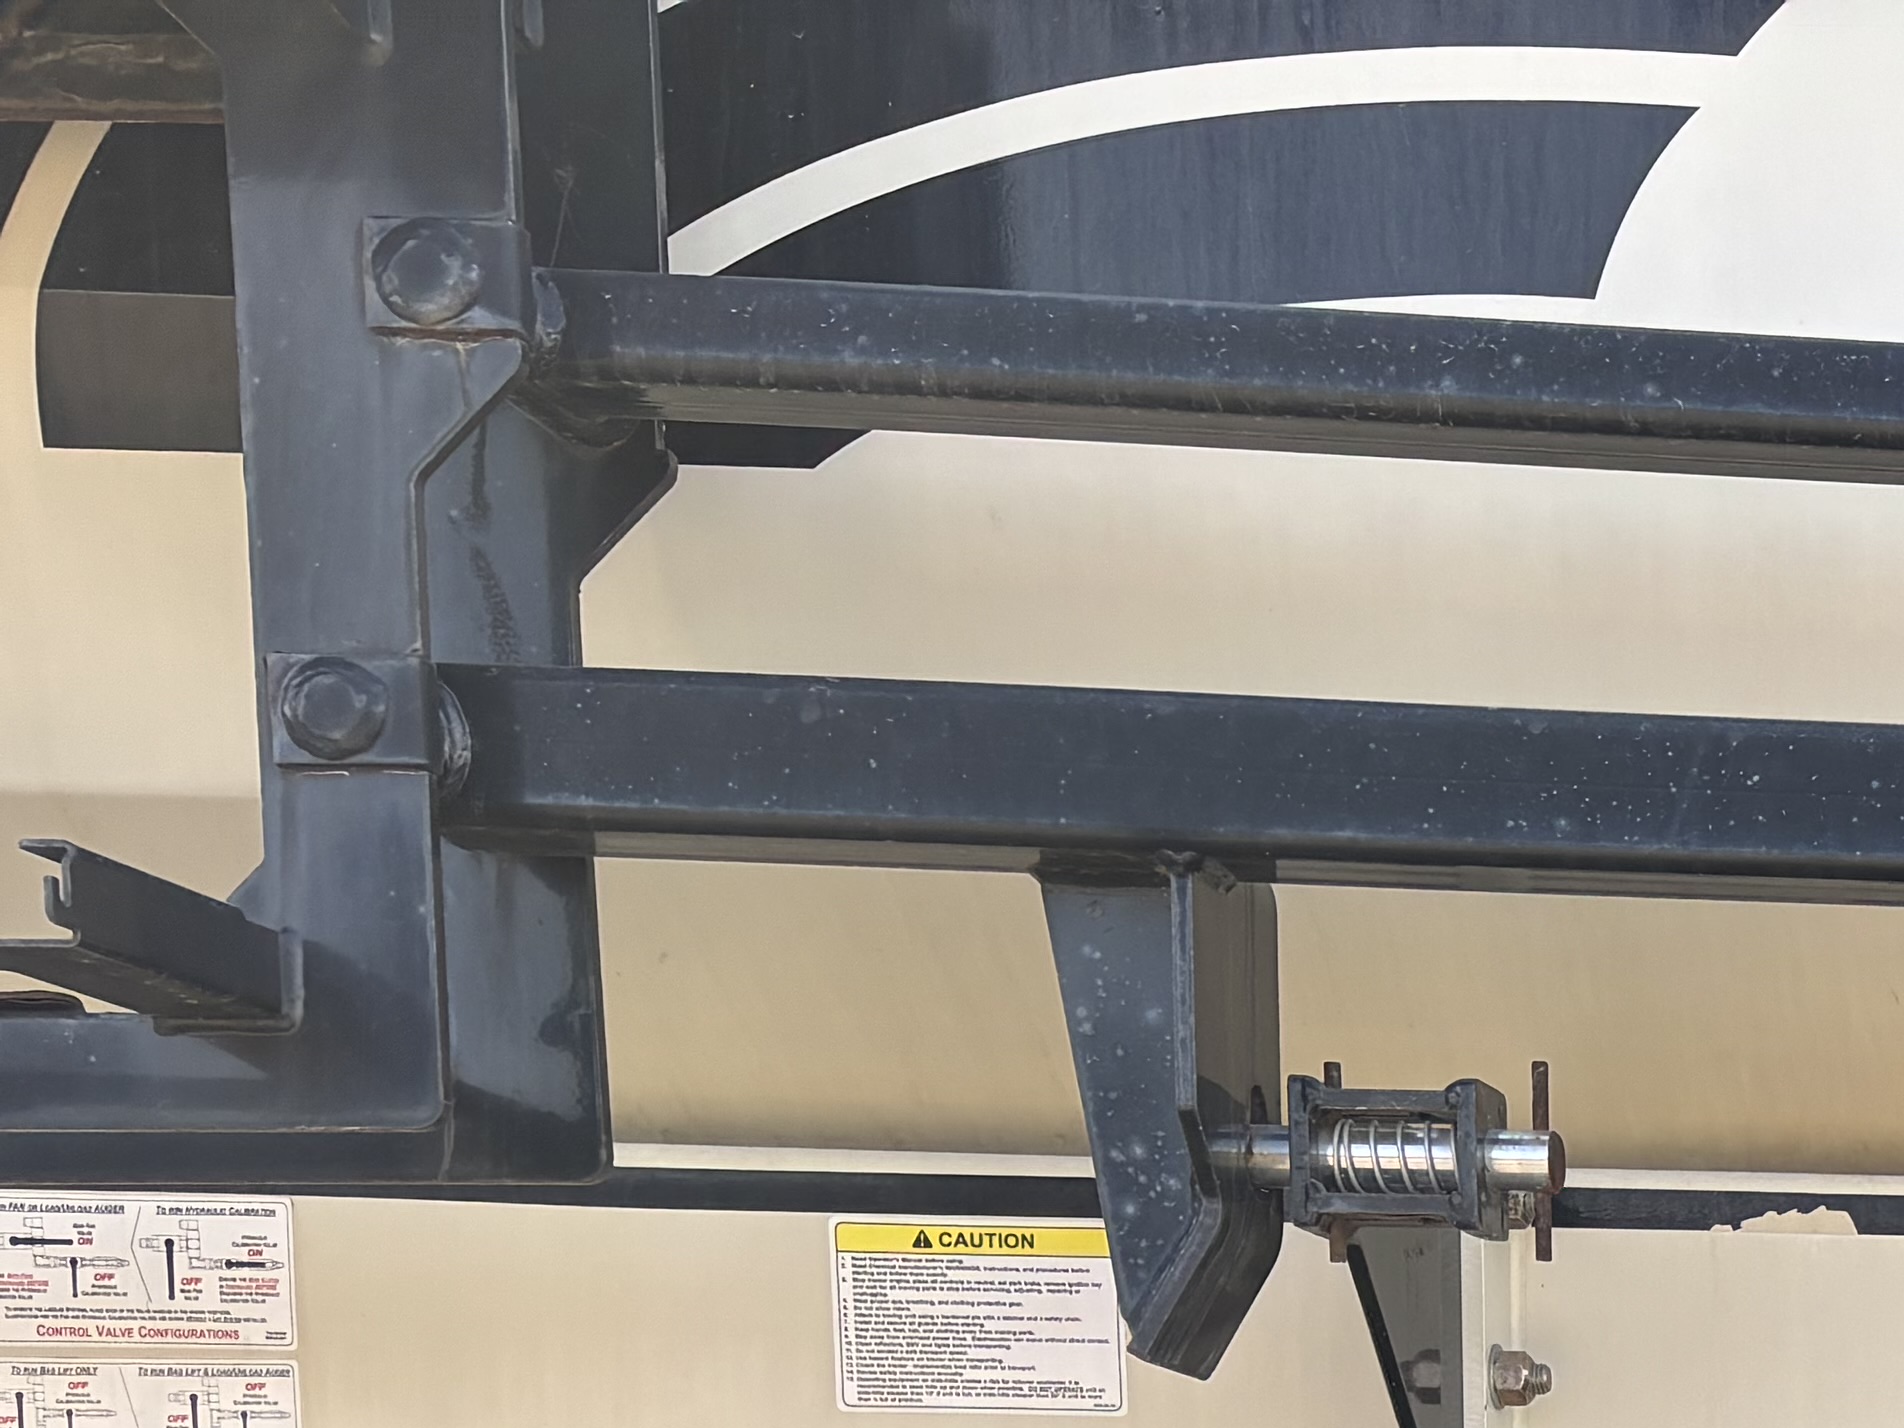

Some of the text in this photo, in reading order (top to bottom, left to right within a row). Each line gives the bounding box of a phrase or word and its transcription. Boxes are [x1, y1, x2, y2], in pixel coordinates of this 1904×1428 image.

[77, 1237, 93, 1246] ON
[938, 1231, 1035, 1250] CAUTION
[248, 1249, 263, 1257] ON
[94, 1273, 115, 1282] OFF
[181, 1277, 203, 1286] OFF
[36, 1324, 240, 1340] CONTROL VALVE CONFIGURATIONS
[68, 1382, 89, 1390] OFF
[245, 1383, 266, 1391] OFF
[167, 1415, 188, 1423] OFF
